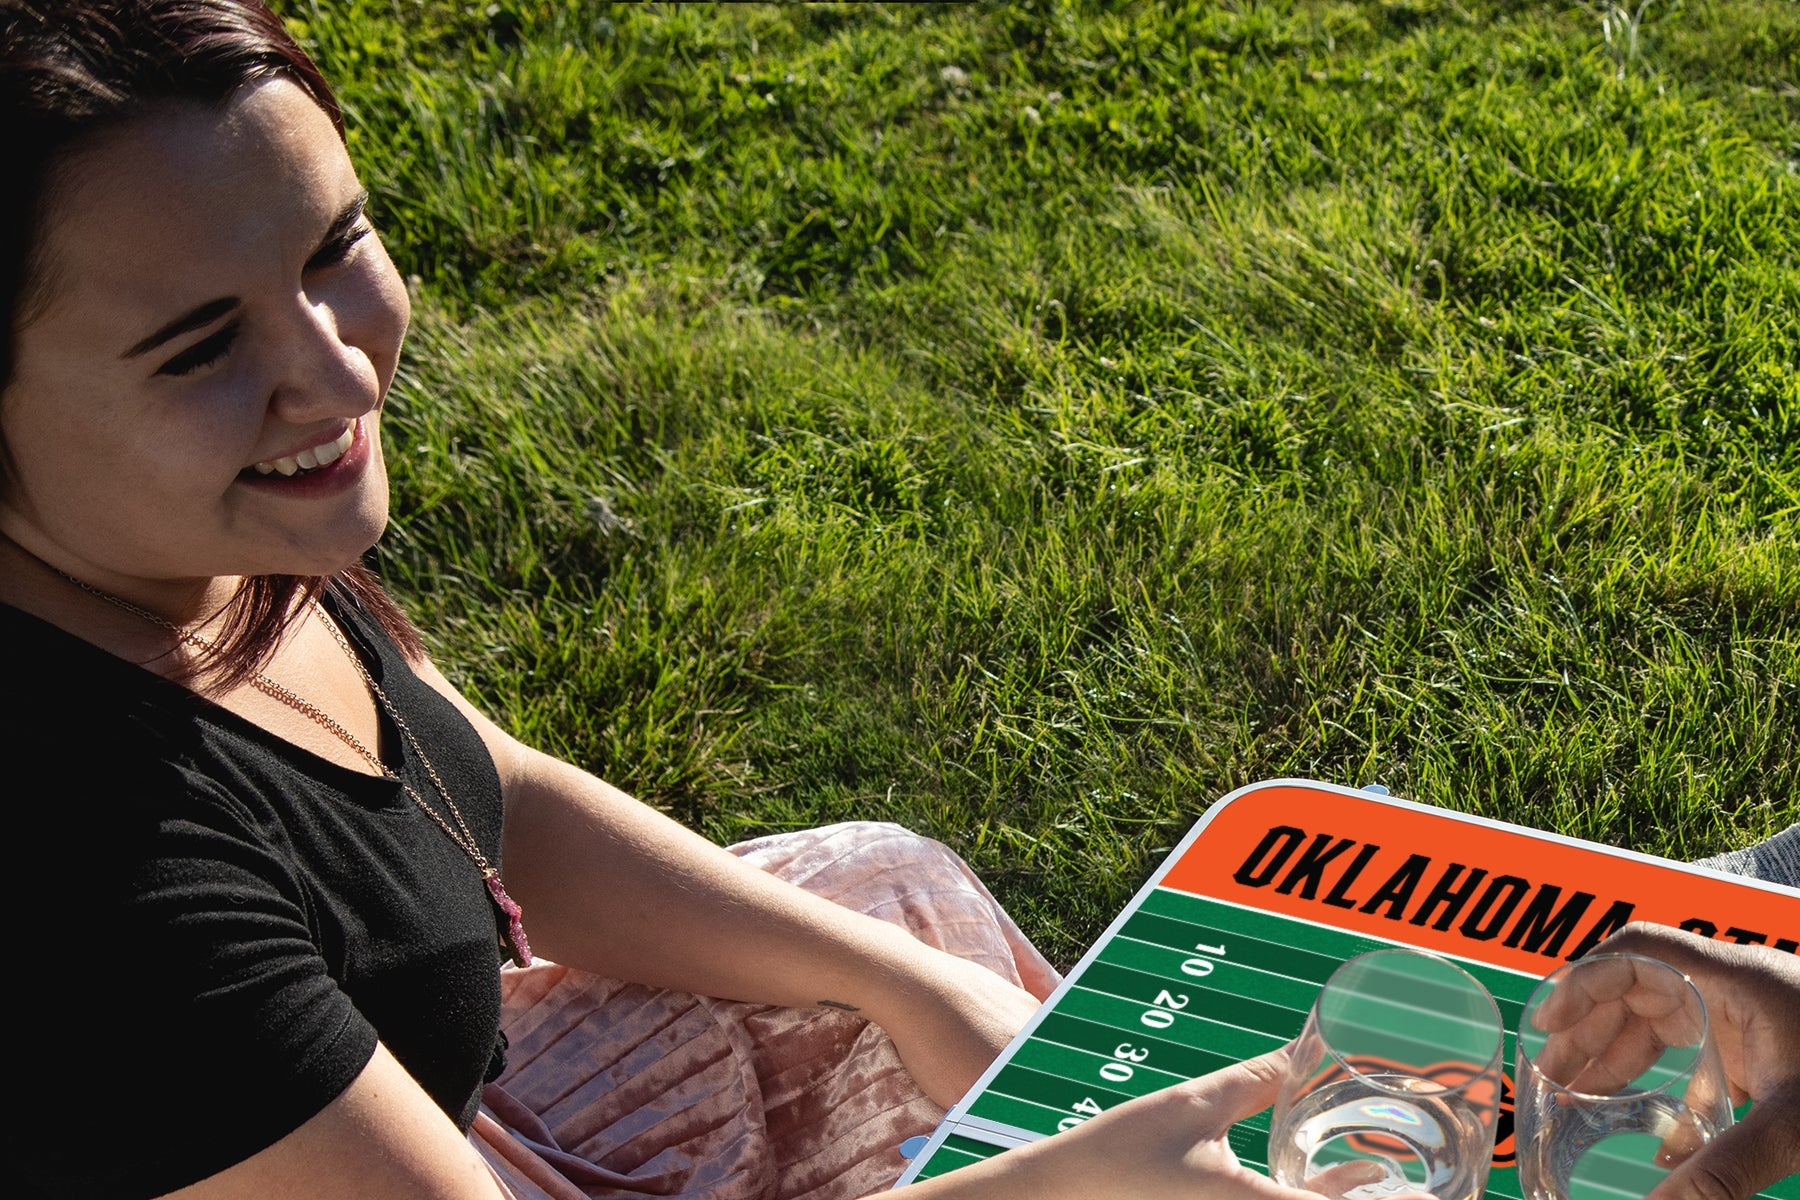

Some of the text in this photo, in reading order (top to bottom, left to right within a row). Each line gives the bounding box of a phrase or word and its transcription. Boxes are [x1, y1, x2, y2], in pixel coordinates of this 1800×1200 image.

[1233, 825, 1636, 963] OKLAHOMA
[1180, 943, 1226, 977] 10
[1140, 989, 1190, 1029] 20
[1099, 1042, 1149, 1082] 30
